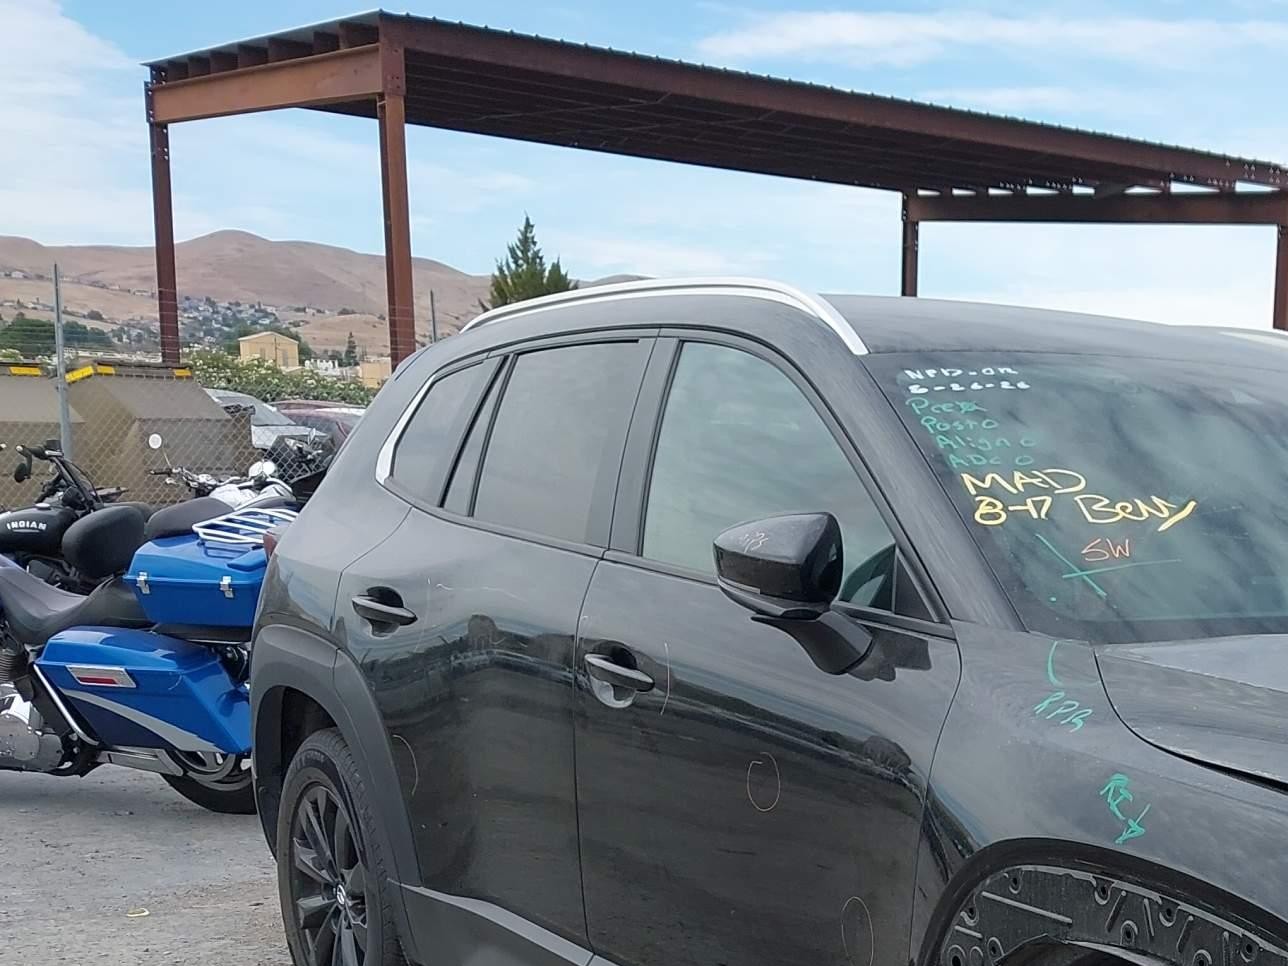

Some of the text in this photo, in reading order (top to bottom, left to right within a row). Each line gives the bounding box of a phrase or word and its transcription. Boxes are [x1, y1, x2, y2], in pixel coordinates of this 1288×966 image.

[960, 469, 1086, 496] MAD
[974, 495, 1052, 526] 8-17
[6, 520, 47, 531] INDIAN
